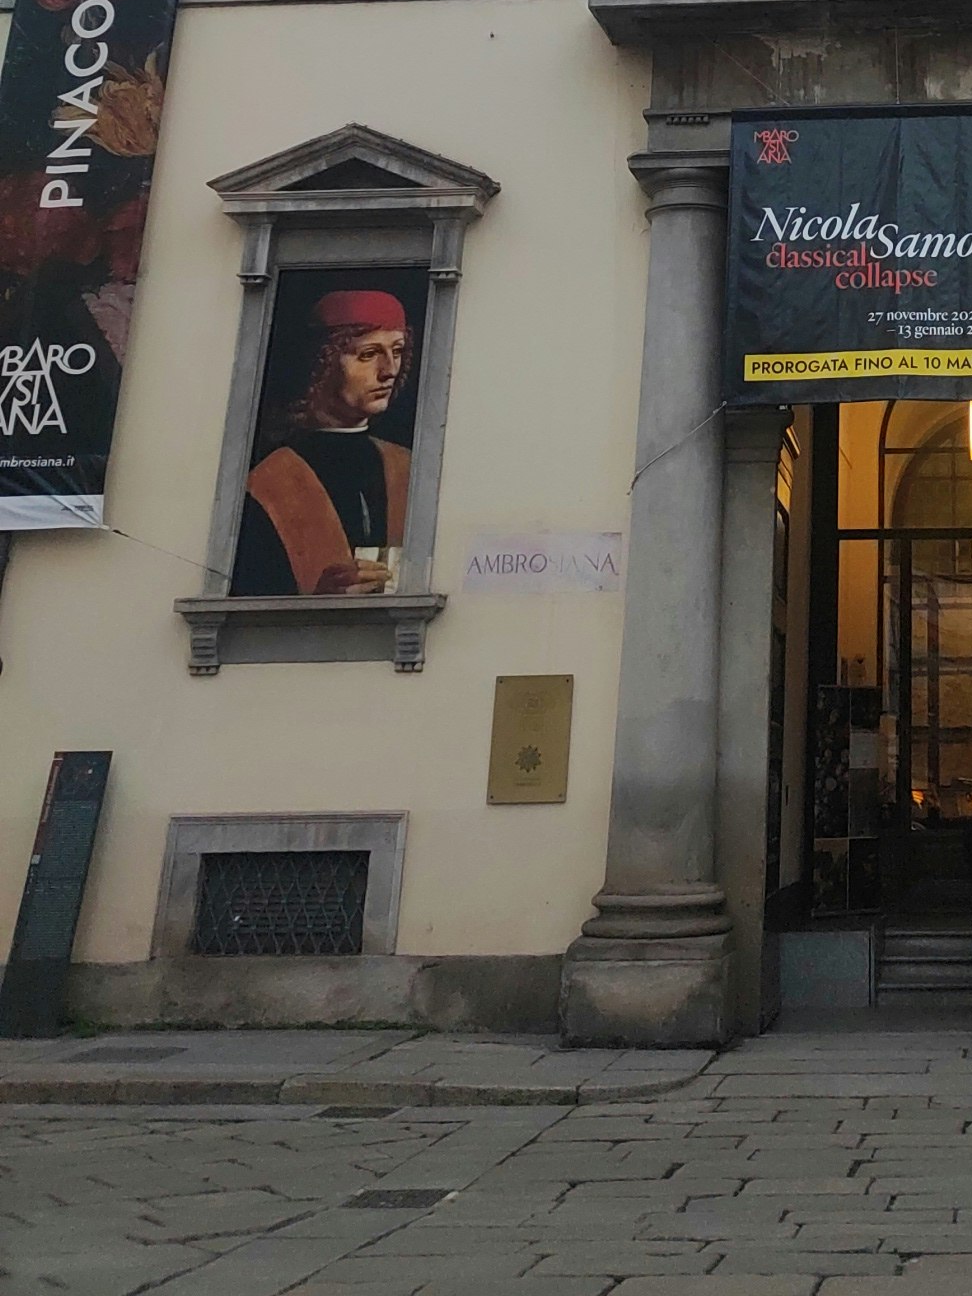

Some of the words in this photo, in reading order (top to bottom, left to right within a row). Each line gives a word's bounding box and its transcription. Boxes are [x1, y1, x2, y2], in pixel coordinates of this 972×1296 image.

[750, 202, 879, 242] Nicola
[766, 242, 867, 268] classical
[835, 262, 938, 294] collapse
[867, 310, 884, 325] 27
[886, 308, 949, 322] novembre
[914, 324, 964, 339] gennaio
[752, 358, 849, 374] PROROGATA
[855, 356, 893, 371] FINO
[898, 355, 918, 369] AL
[924, 356, 941, 369] 10
[0, 454, 75, 468] mbrosiana.it
